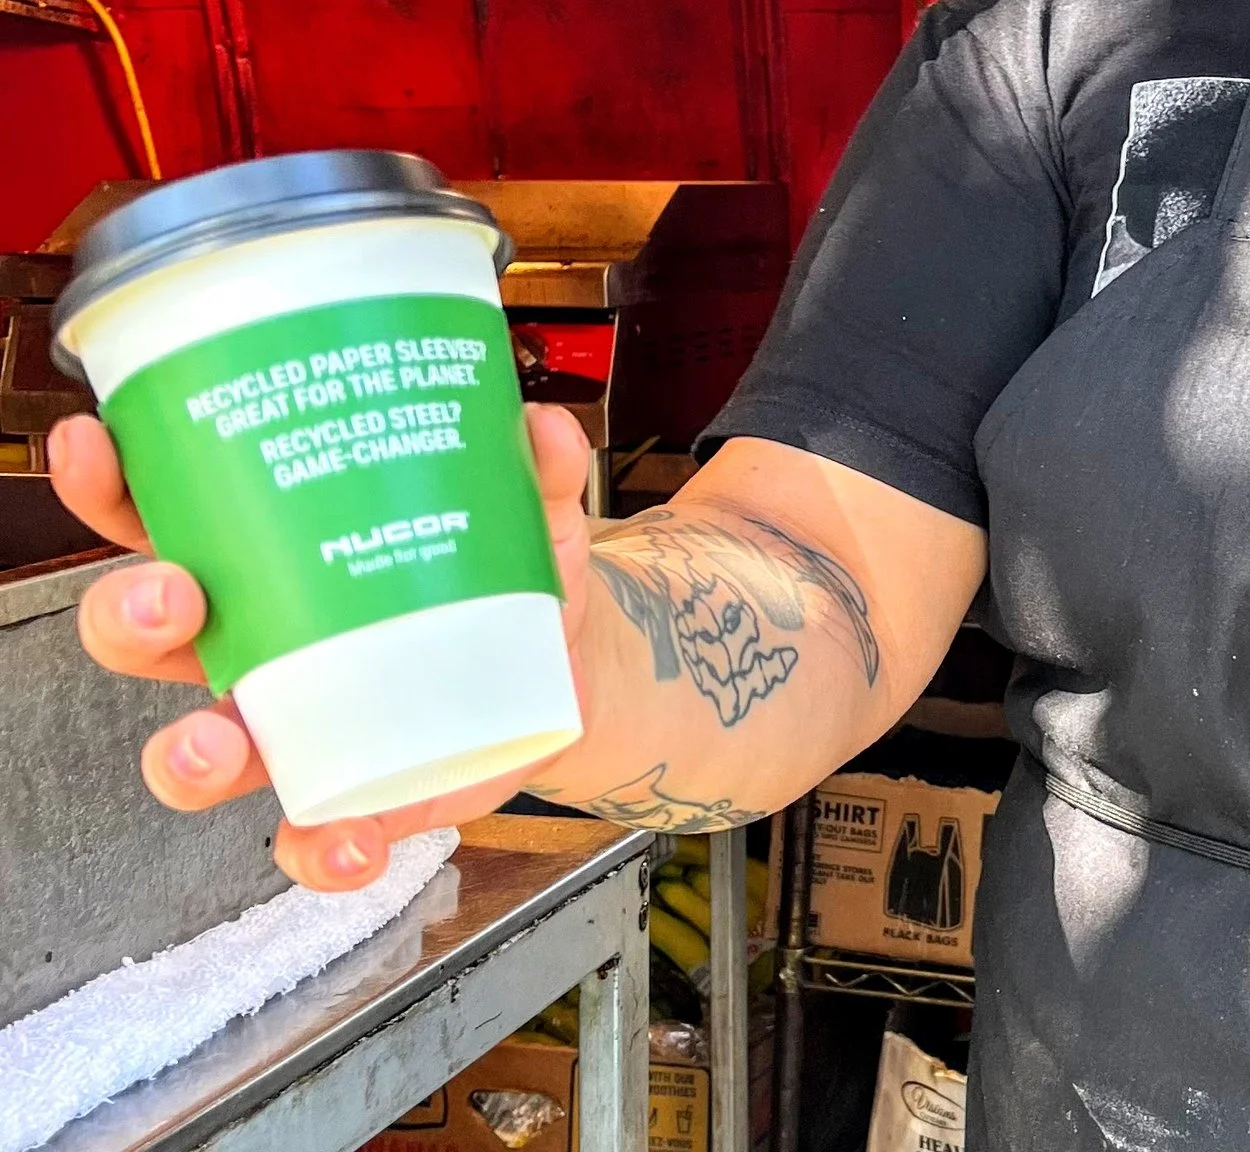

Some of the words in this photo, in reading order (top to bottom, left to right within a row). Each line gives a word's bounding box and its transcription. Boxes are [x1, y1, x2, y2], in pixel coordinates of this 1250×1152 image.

[186, 361, 307, 422] RECYCLED
[309, 342, 393, 379] PAPER
[395, 337, 488, 364] SLEEVES?
[214, 395, 291, 439] GREAT
[293, 378, 348, 414] FOR
[348, 368, 399, 398] THE
[259, 409, 388, 465] RECYCLED
[388, 400, 463, 429] STEEL?
[273, 427, 467, 490] GAME-CHANGER.
[320, 510, 471, 565] NUCOR
